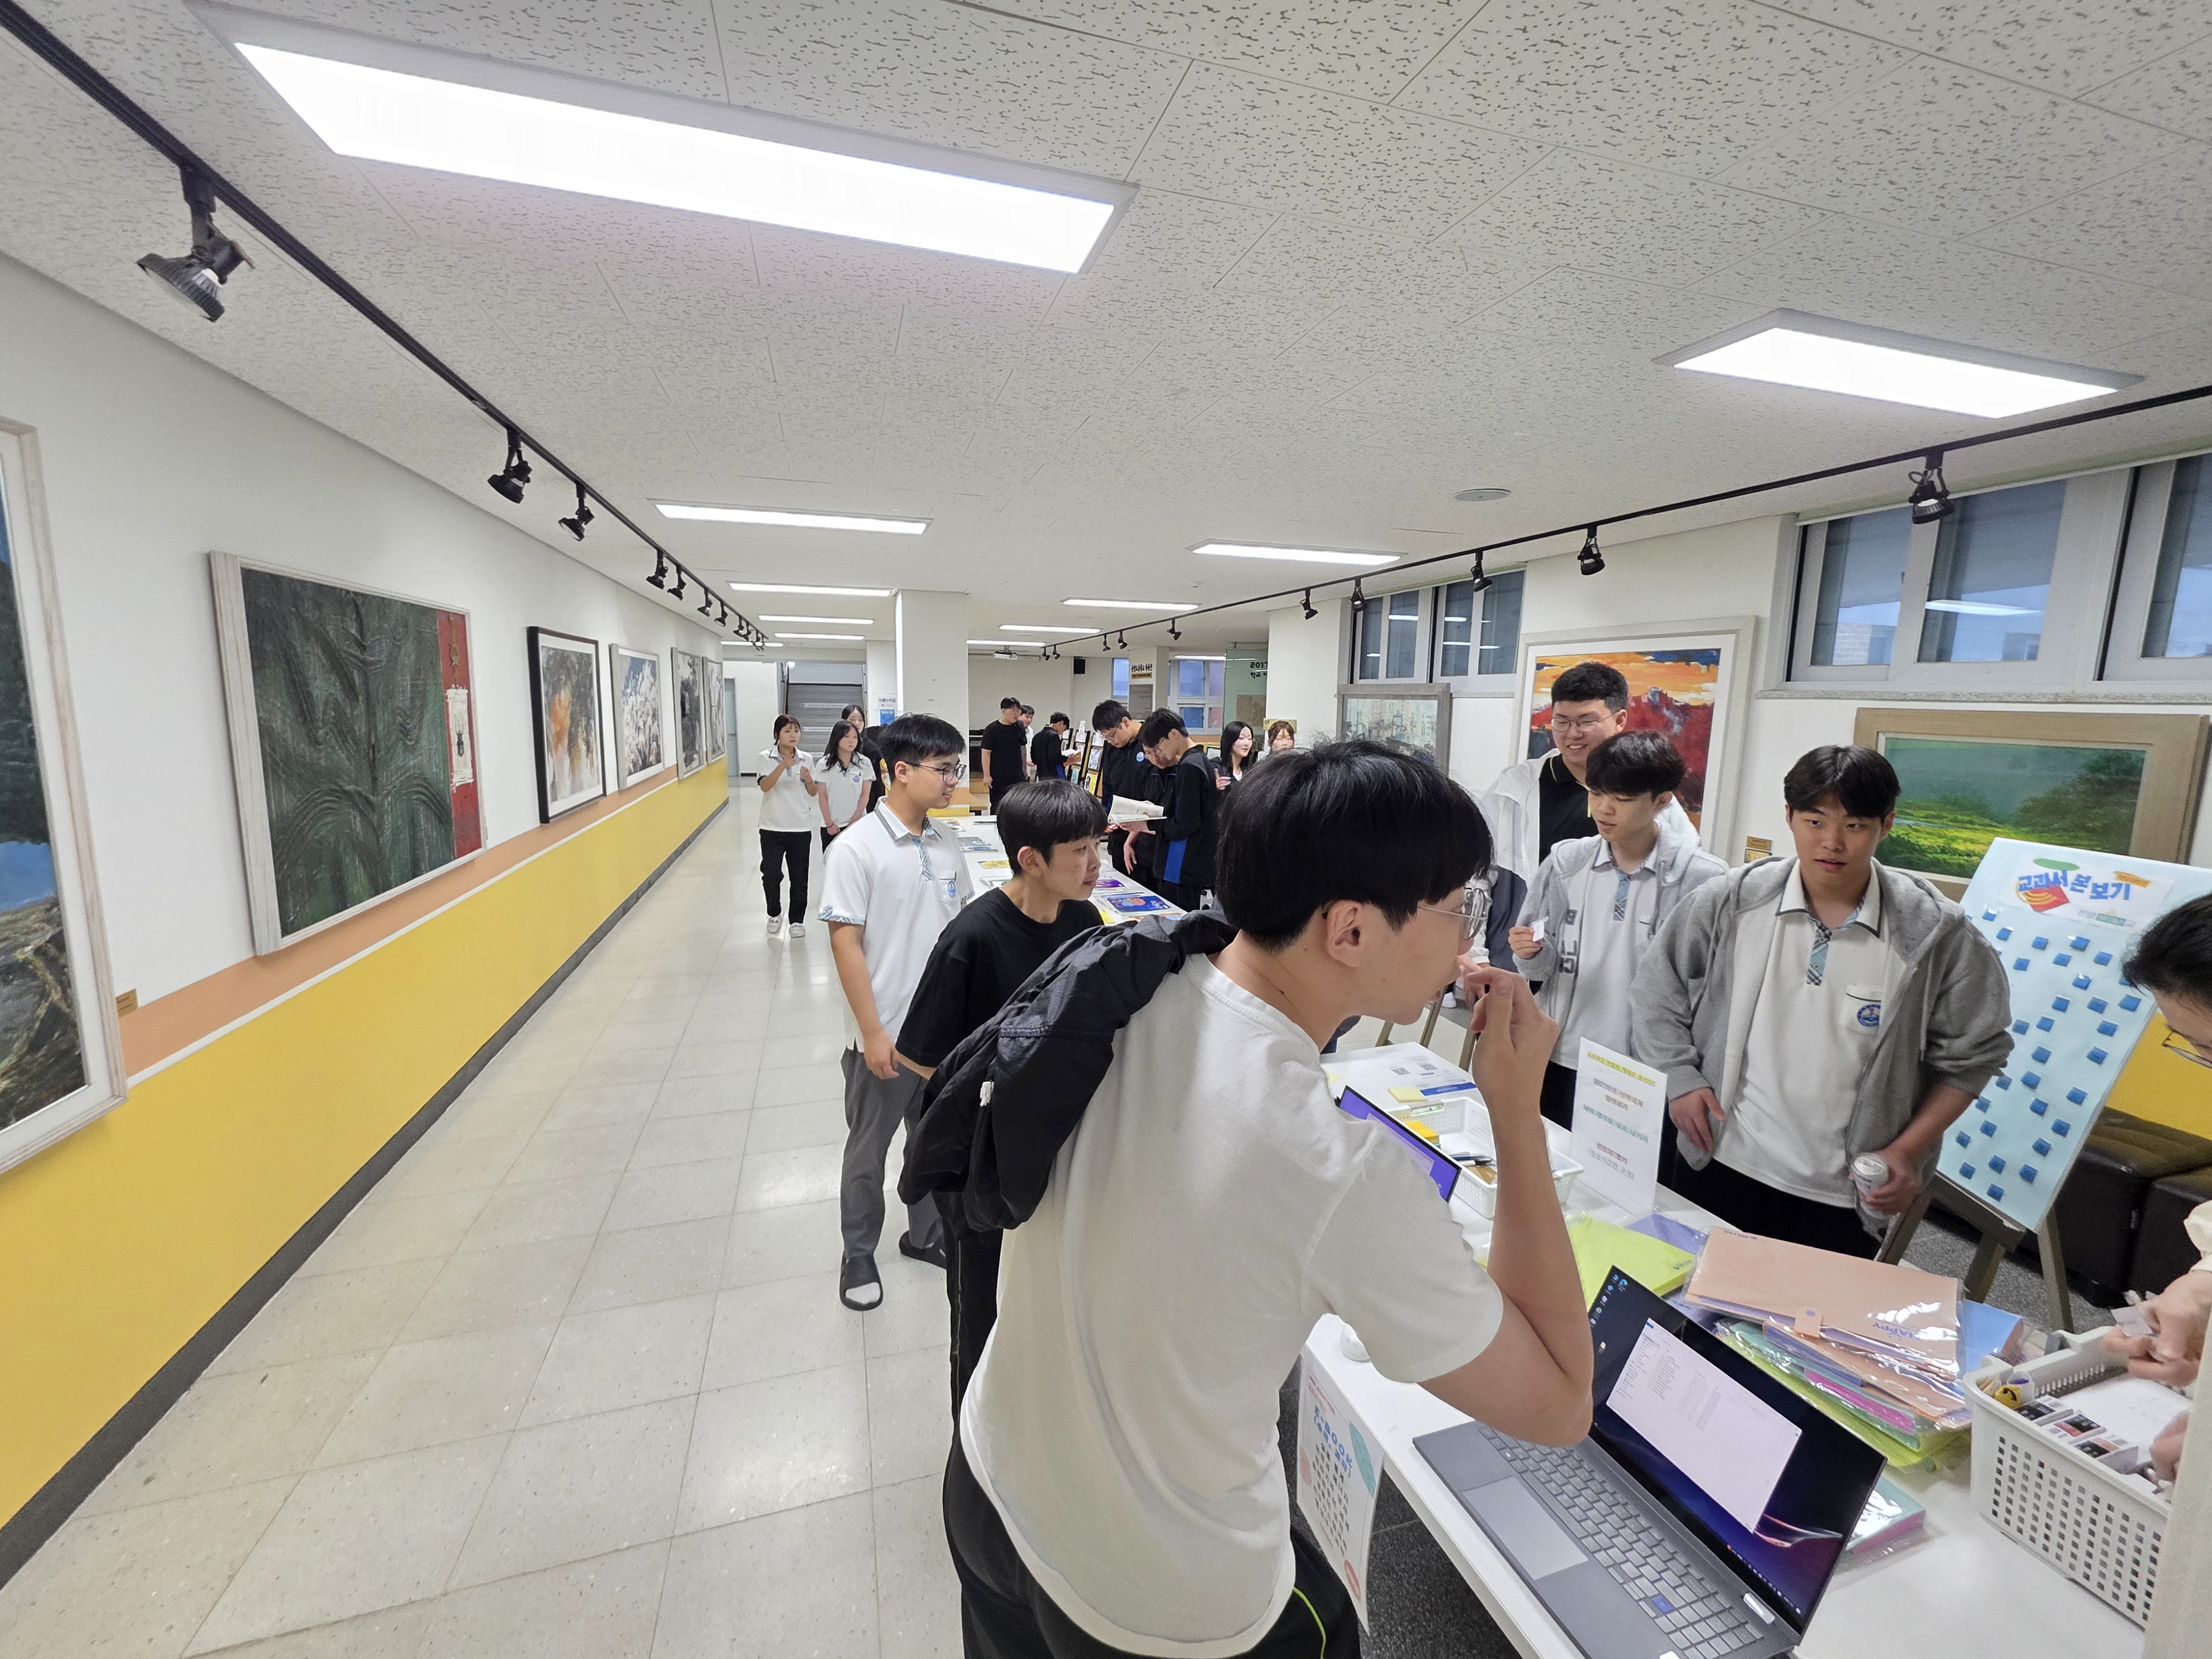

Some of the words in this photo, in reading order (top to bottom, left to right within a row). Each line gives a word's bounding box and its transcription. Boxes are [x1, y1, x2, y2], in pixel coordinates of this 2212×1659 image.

[2018, 869, 2068, 891] 교과서
[2069, 874, 2092, 893] 본
[2089, 883, 2130, 900] 보기
[1314, 1405, 1353, 1468] E-BOOK
